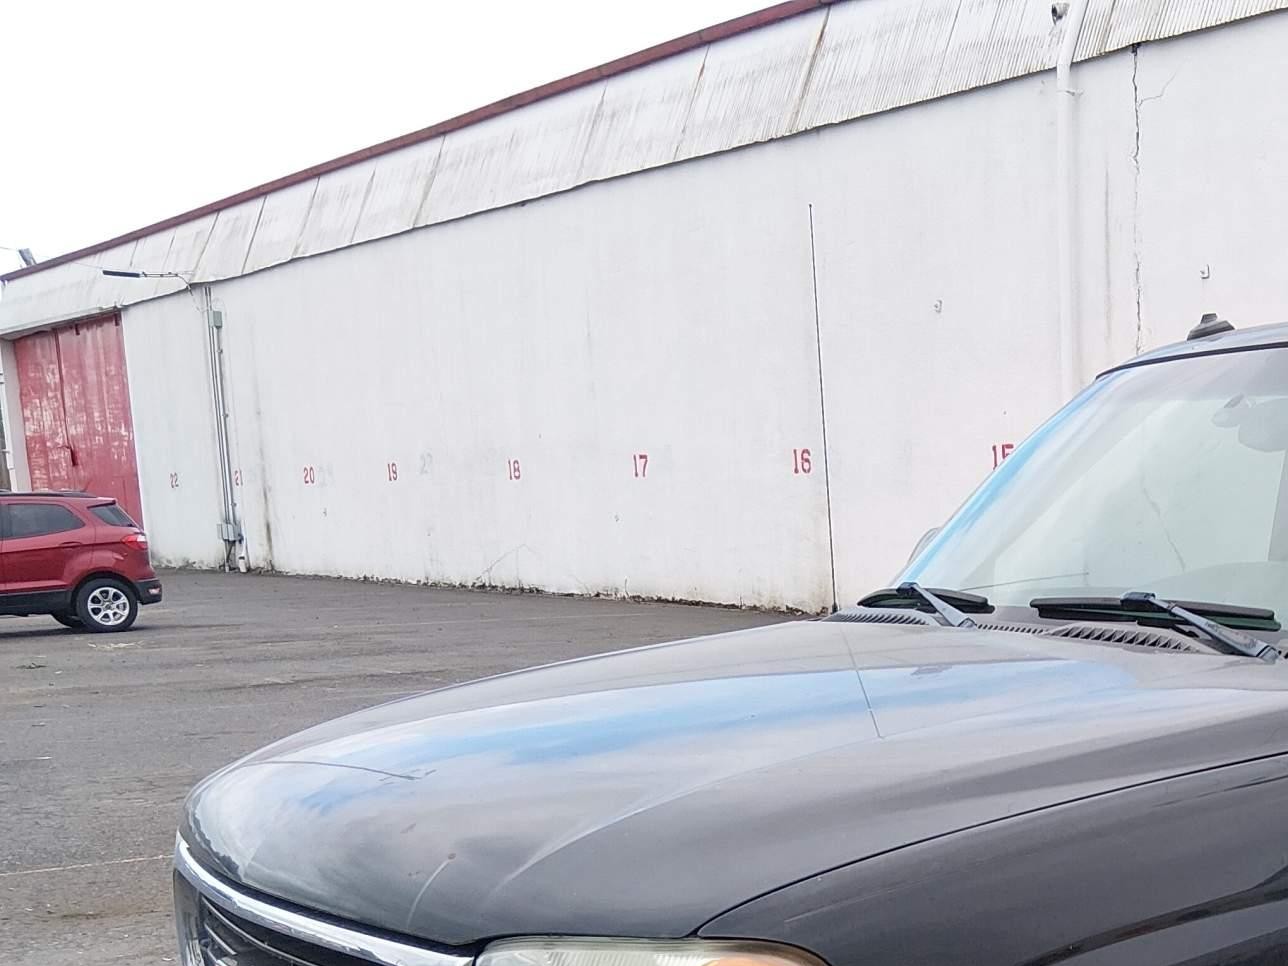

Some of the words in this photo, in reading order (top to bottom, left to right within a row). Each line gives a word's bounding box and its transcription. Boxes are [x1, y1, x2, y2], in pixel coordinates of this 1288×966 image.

[507, 459, 521, 480] 18
[633, 453, 649, 478] 17
[792, 448, 812, 474] 16
[303, 466, 315, 484] 20
[387, 462, 398, 482] 19
